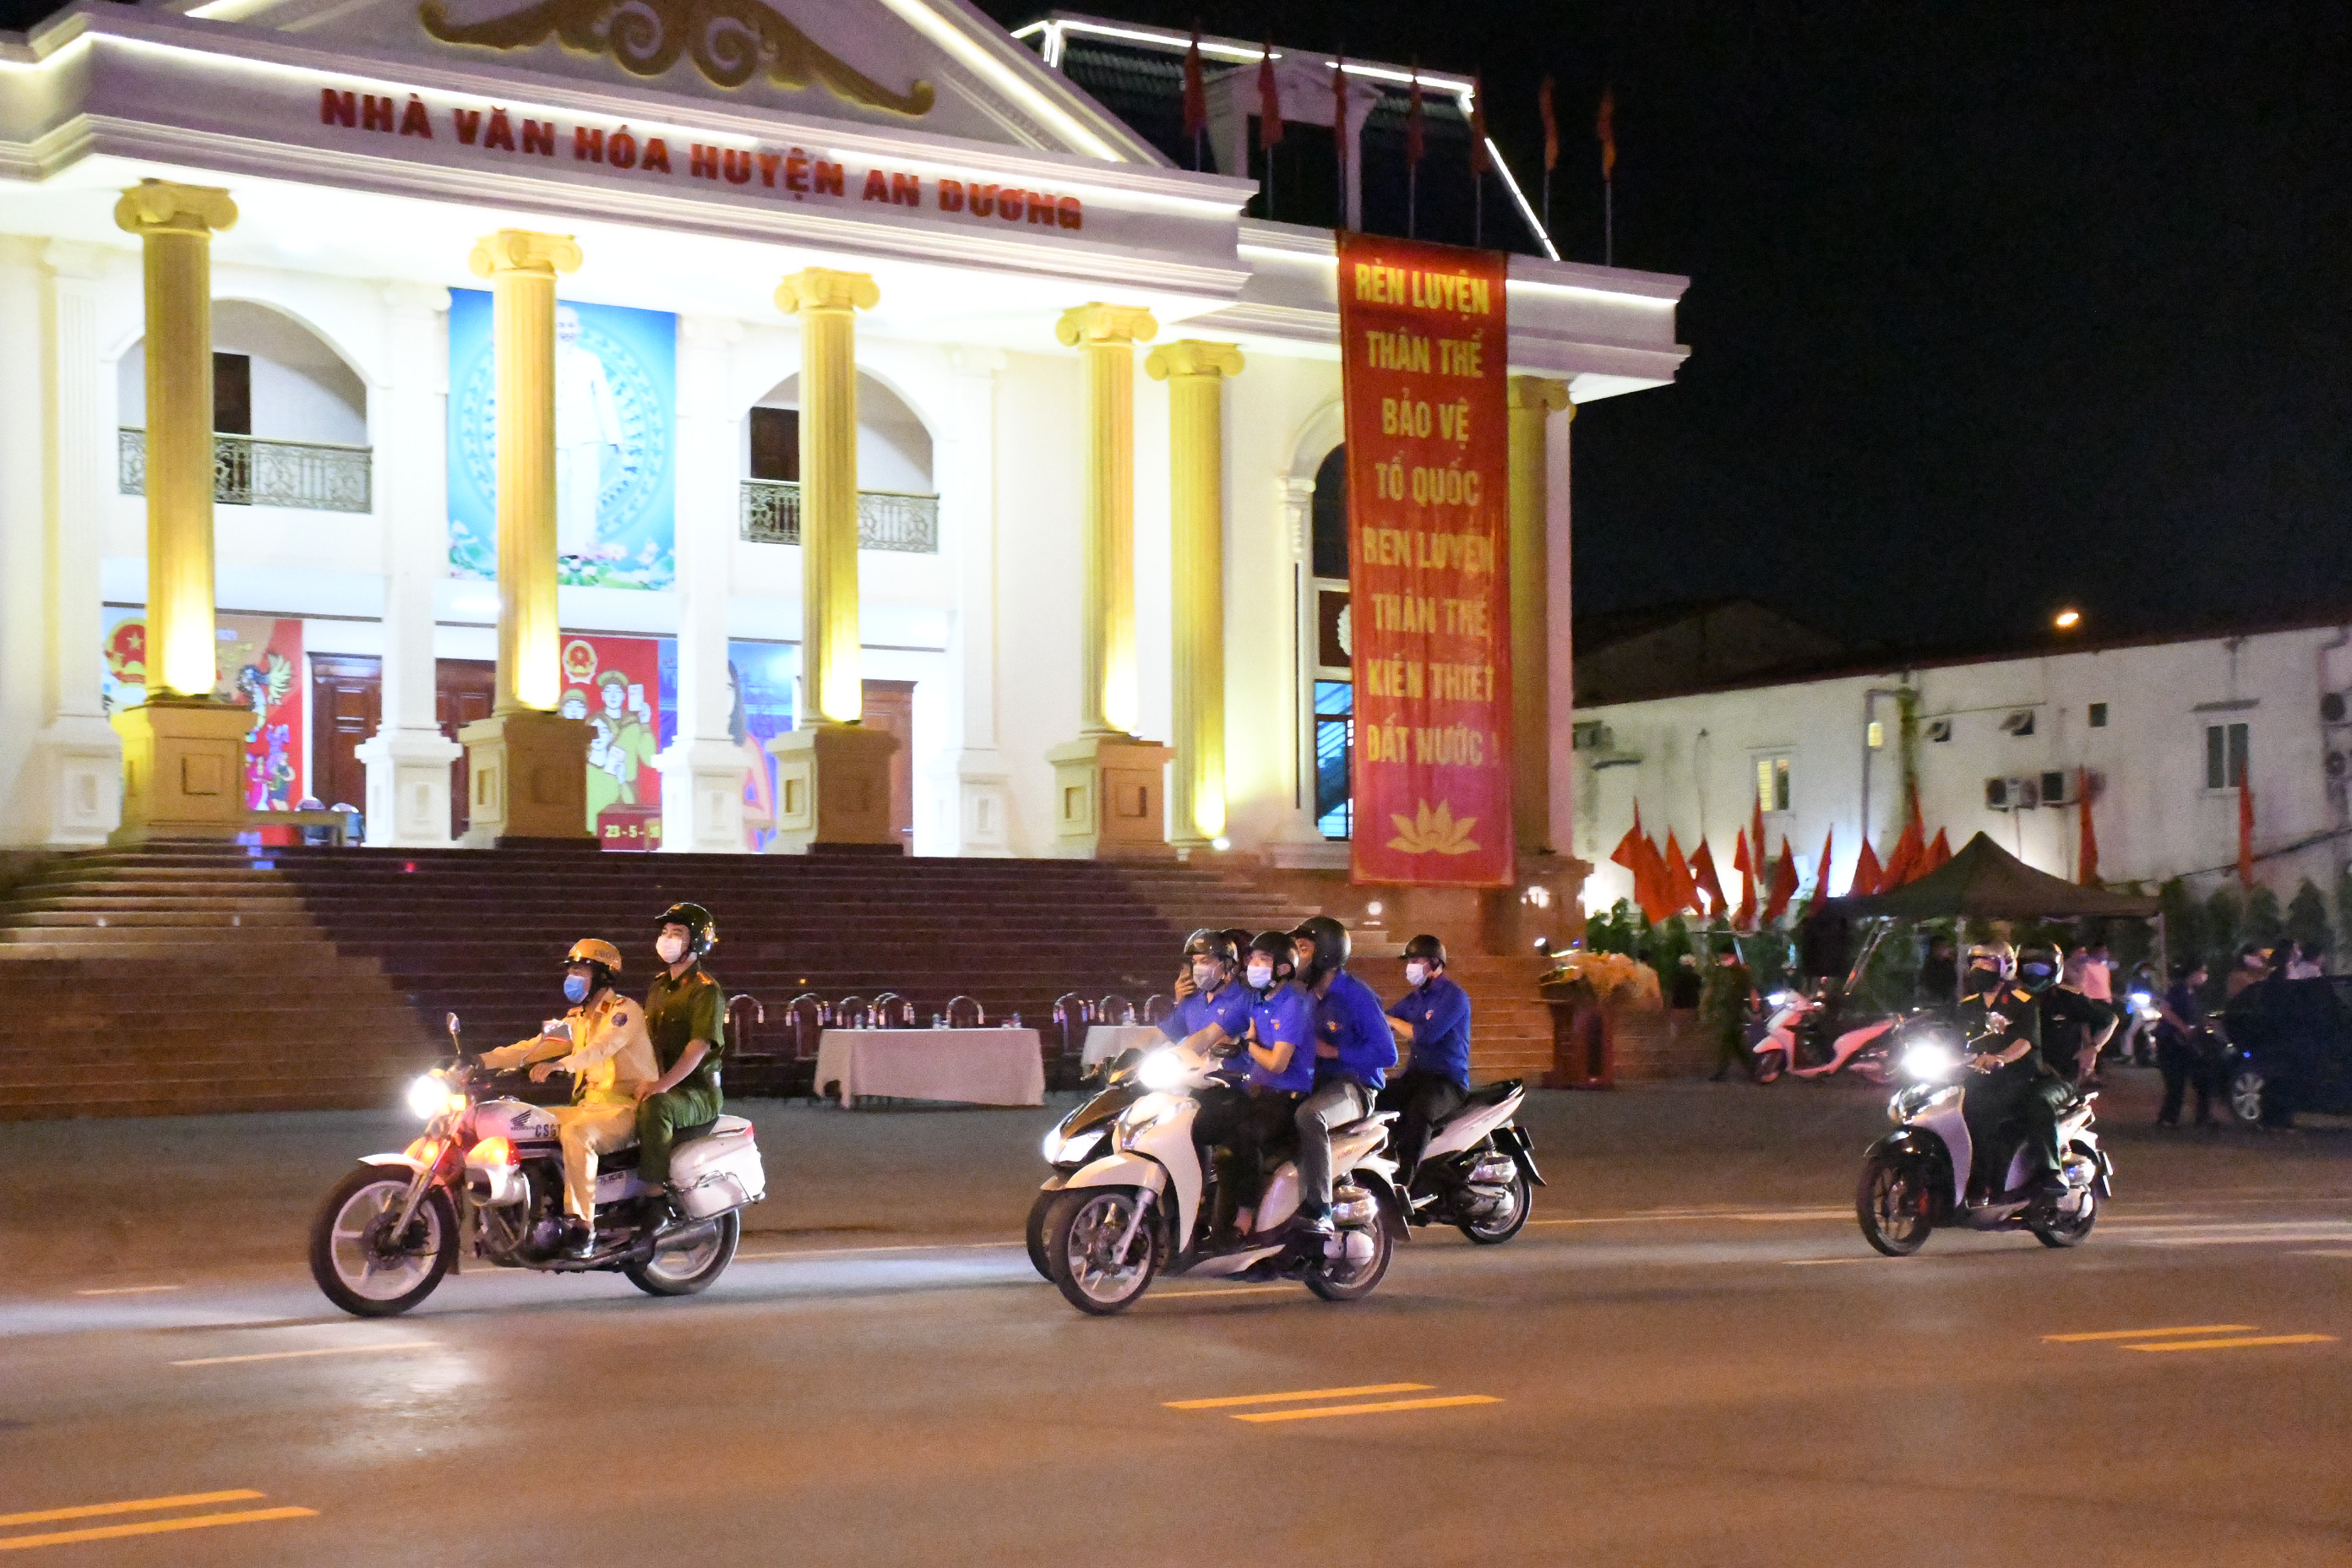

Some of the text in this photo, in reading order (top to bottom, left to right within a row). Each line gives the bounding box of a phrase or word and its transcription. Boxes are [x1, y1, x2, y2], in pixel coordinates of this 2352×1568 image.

[320, 88, 1082, 230] NHÀ VĂN HÓA HUYỆN AN DƯƠNG
[1355, 258, 1490, 321] RÈN LUYỆN
[1366, 327, 1484, 378] THÂN THỂ
[1381, 388, 1470, 450] BẢO VỆ
[1375, 449, 1482, 507] TỔ QUỐC
[1367, 713, 1409, 764] ĐẤT
[1415, 722, 1484, 767] NƯỚC
